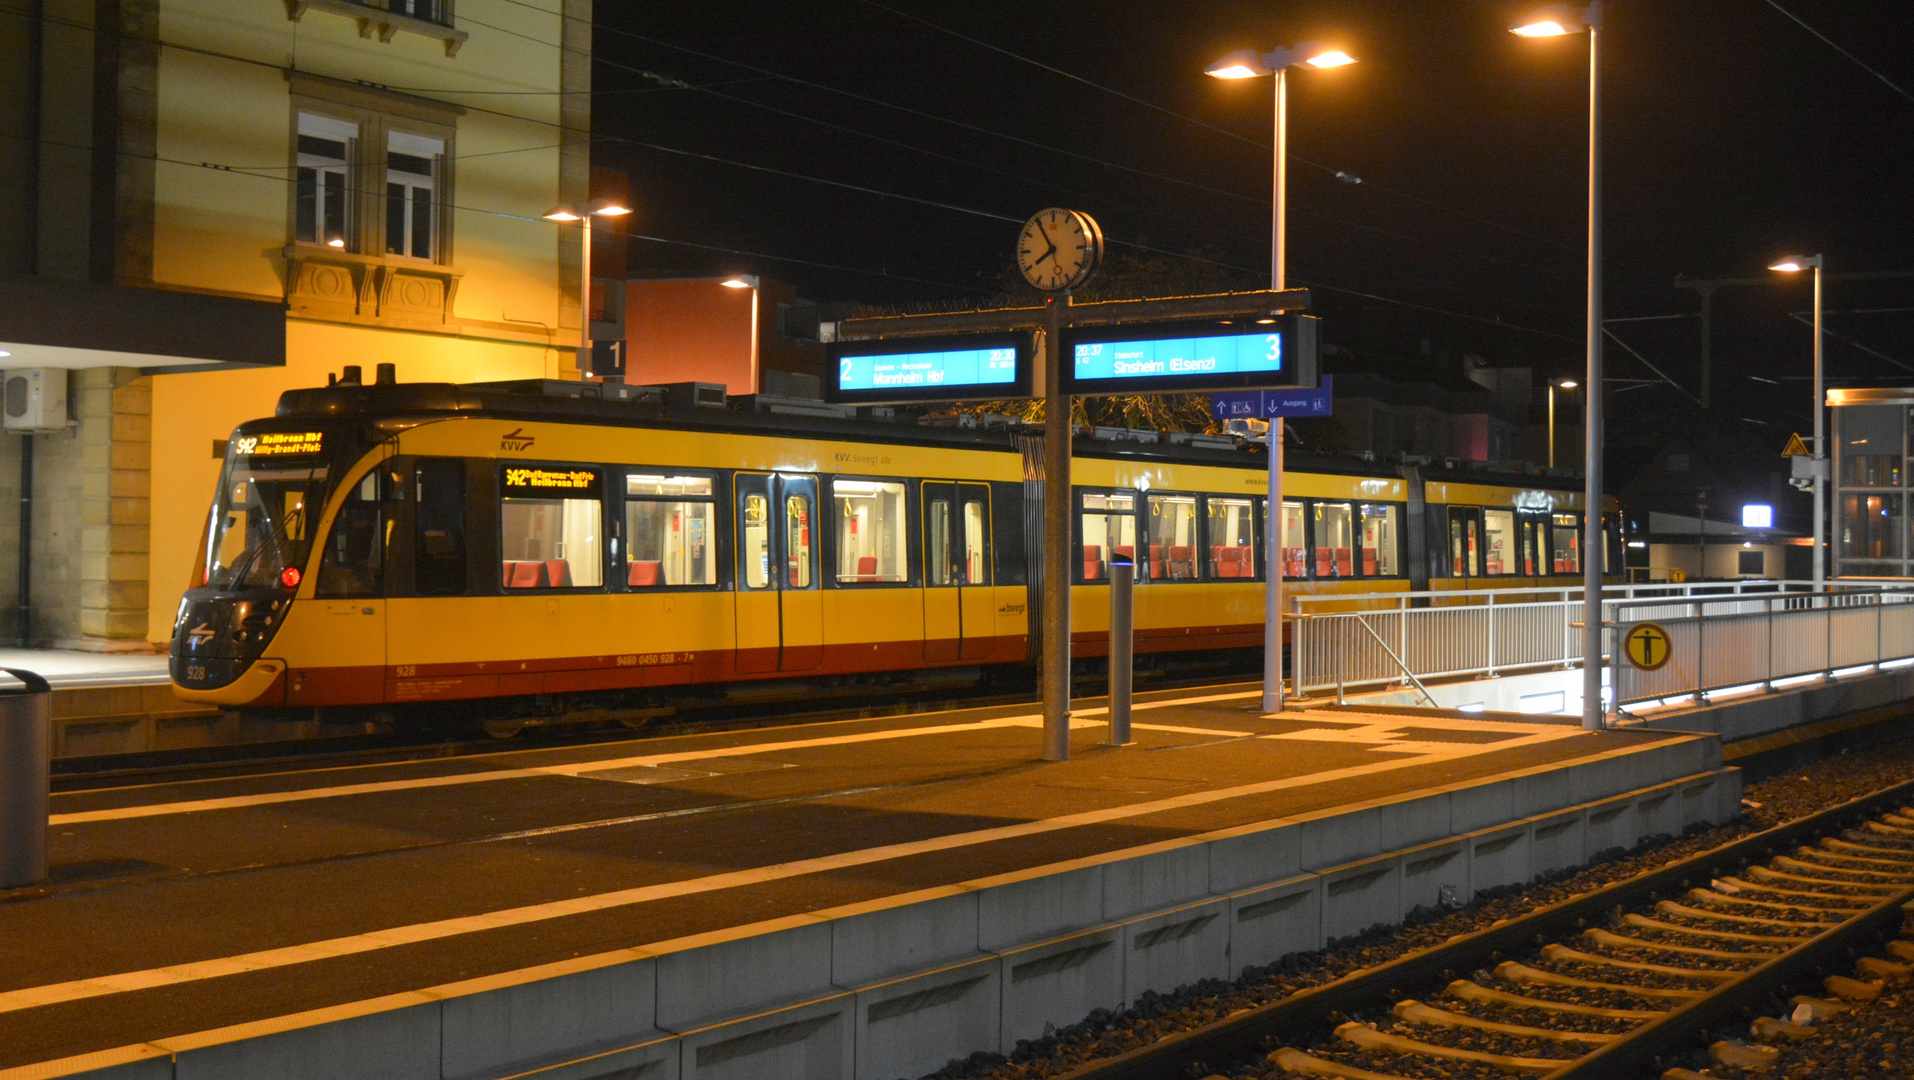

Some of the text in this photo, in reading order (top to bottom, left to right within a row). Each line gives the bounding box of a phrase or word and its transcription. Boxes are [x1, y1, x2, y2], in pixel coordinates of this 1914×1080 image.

[1076, 345, 1102, 356] 20:37
[1266, 335, 1280, 360] 3
[610, 341, 620, 368] 1
[990, 350, 1015, 361] 20:30
[840, 358, 852, 381] 2
[1114, 357, 1216, 374] Sinsheim (Elsenz)
[873, 370, 945, 385] Mannheim Hbf
[262, 432, 322, 444] Heilbronn Hbf
[236, 438, 258, 454] S42
[500, 440, 521, 451] KVV
[530, 478, 588, 488] Heilbronn Hbf
[616, 656, 637, 666] 9480
[660, 654, 674, 664] 928
[187, 666, 206, 680] 928
[396, 666, 416, 676] 928
